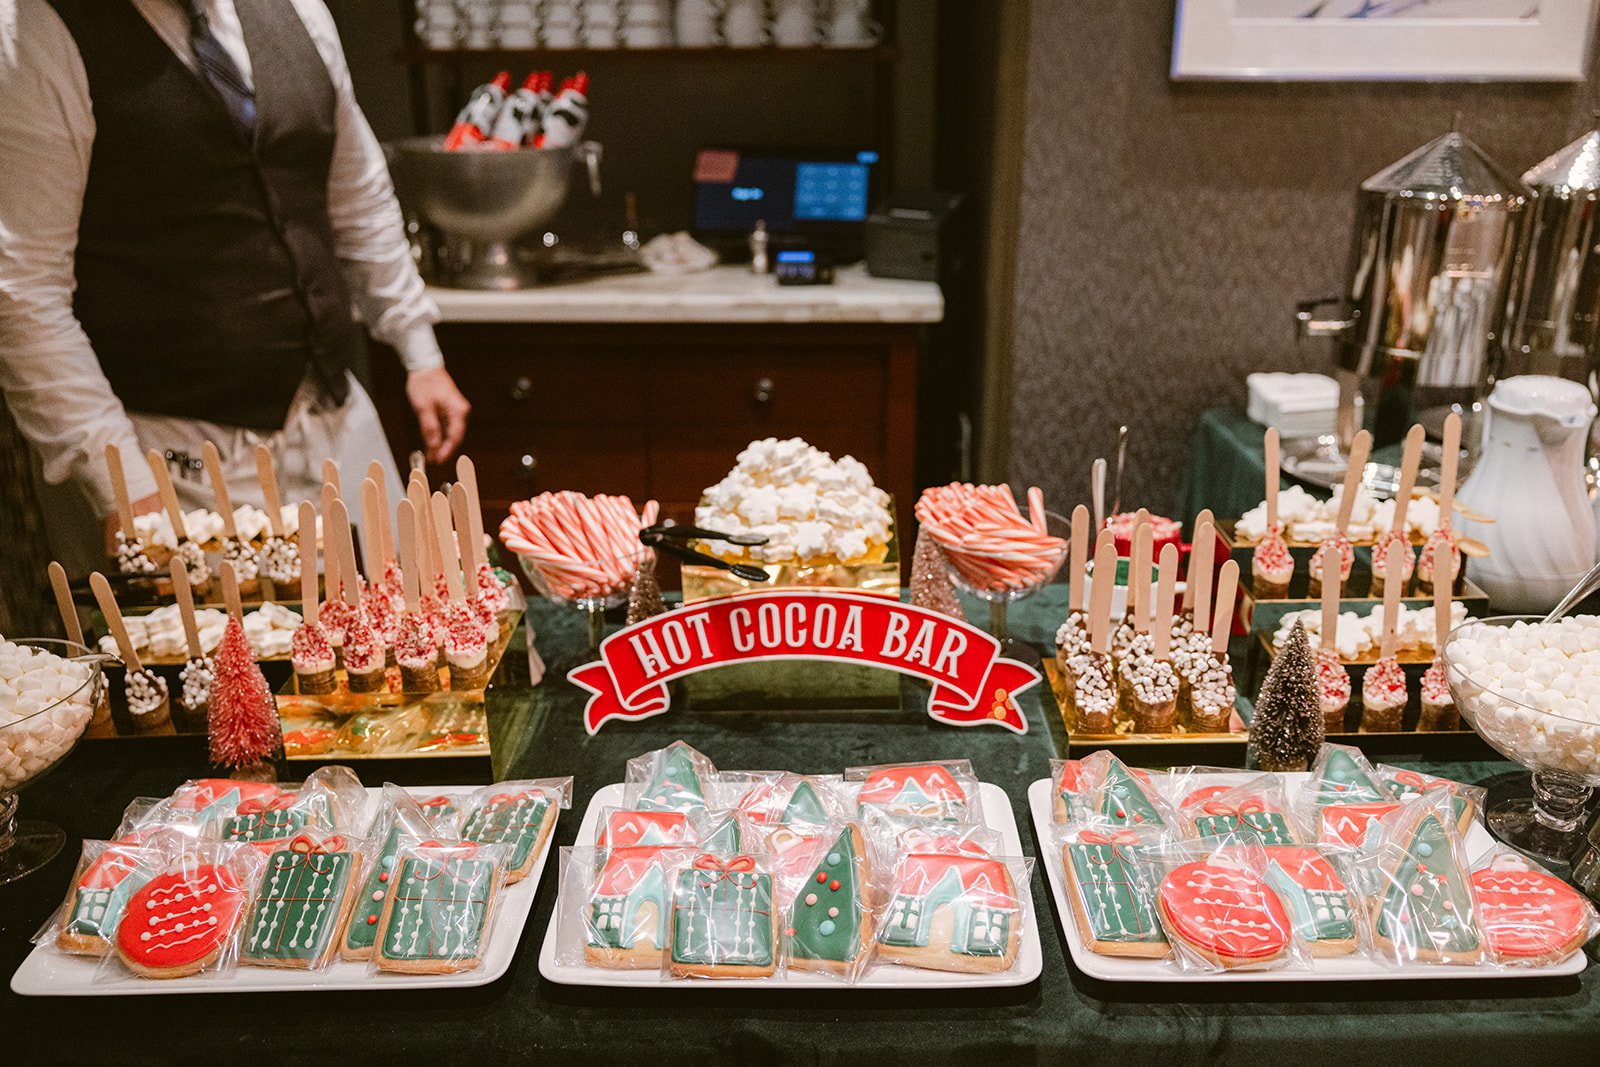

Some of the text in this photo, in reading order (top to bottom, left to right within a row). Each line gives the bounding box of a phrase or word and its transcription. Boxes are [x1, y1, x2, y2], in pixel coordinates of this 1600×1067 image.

[628, 602, 969, 679] HOT COCOA BAR
